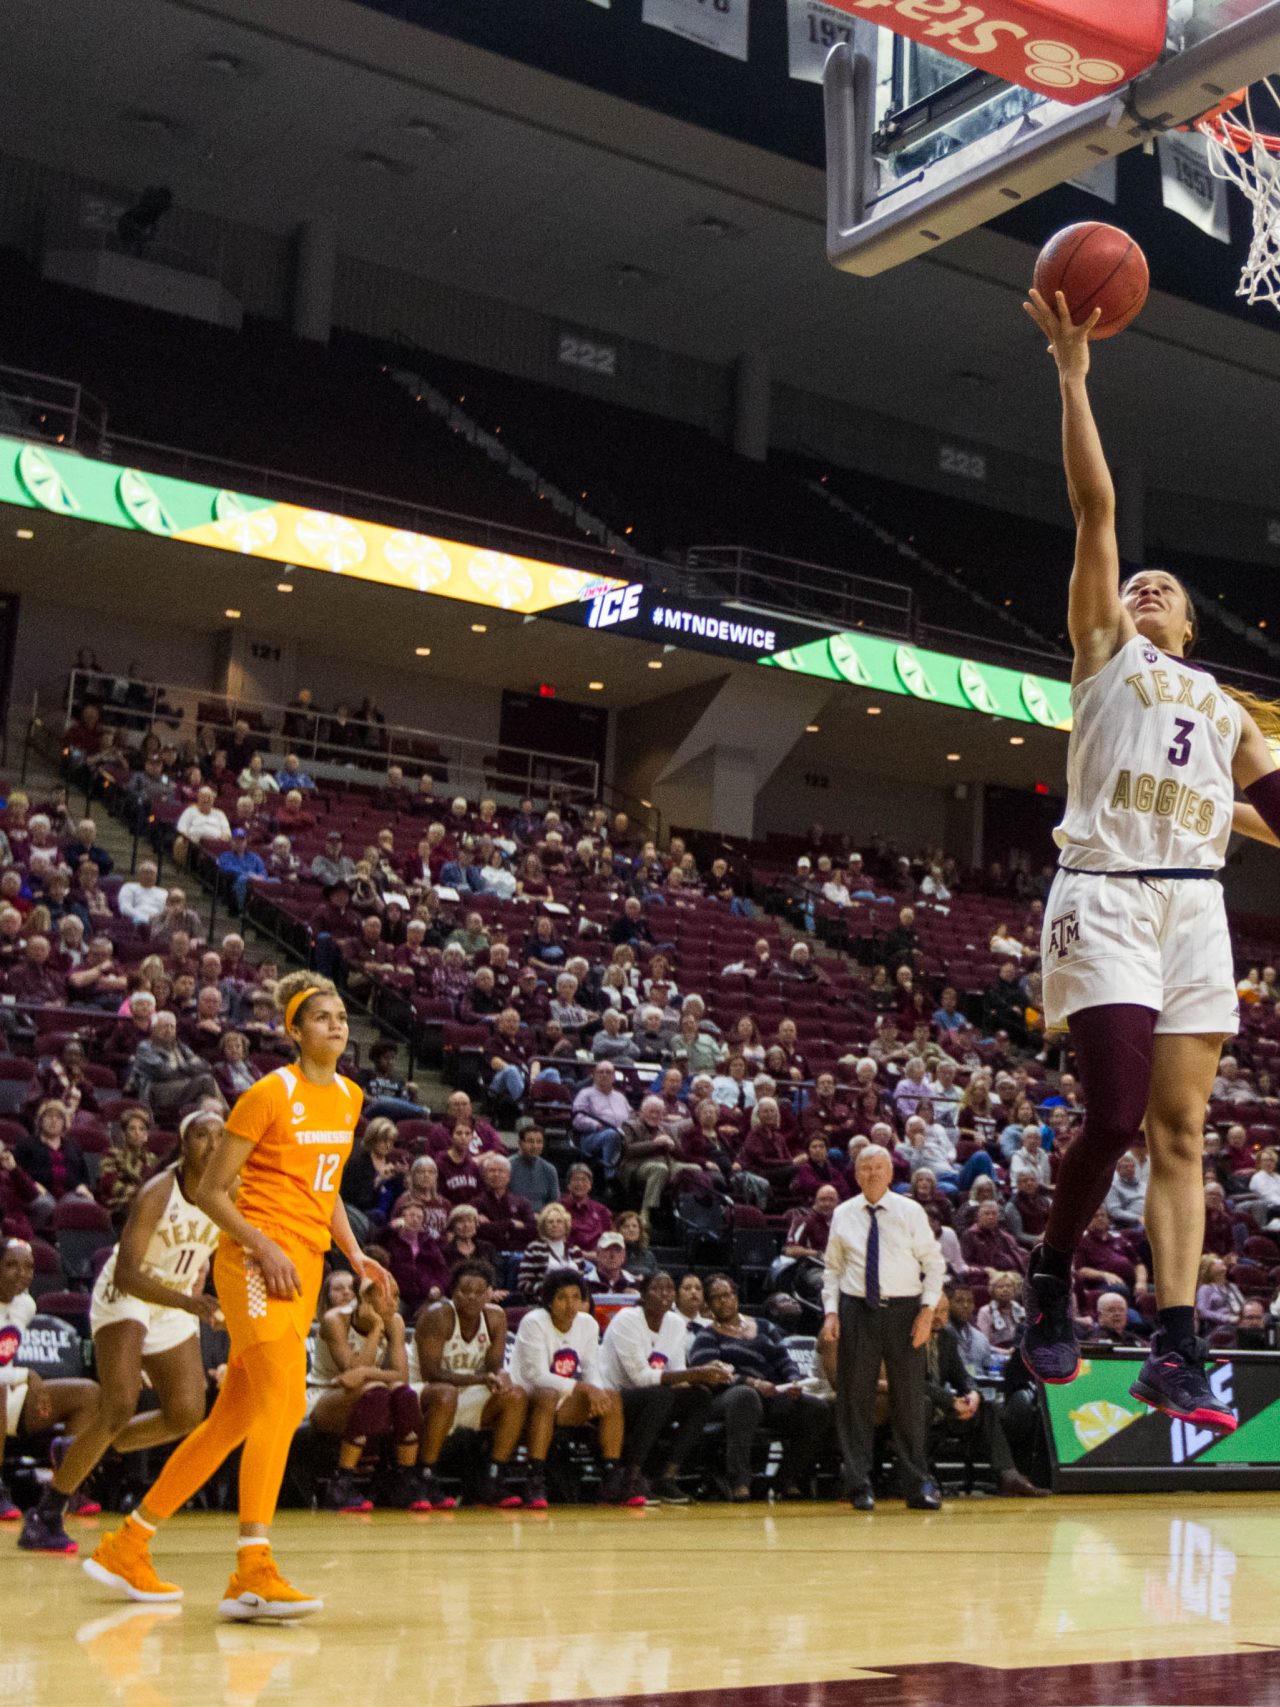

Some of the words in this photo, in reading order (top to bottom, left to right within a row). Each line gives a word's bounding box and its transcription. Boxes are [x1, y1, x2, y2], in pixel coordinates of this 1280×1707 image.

[807, 14, 853, 48] 197
[853, 0, 1028, 54] Sta
[557, 336, 616, 374] 222
[588, 584, 643, 628] ICE
[652, 607, 776, 650] #MTNDEWICE
[1126, 669, 1231, 738] TEXAS
[1168, 718, 1195, 766] 3
[1111, 769, 1215, 836] AGGIES
[313, 1153, 340, 1192] 12
[174, 1250, 195, 1274] 11
[17, 1346, 61, 1362] MILK
[21, 1329, 71, 1349] USCLE
